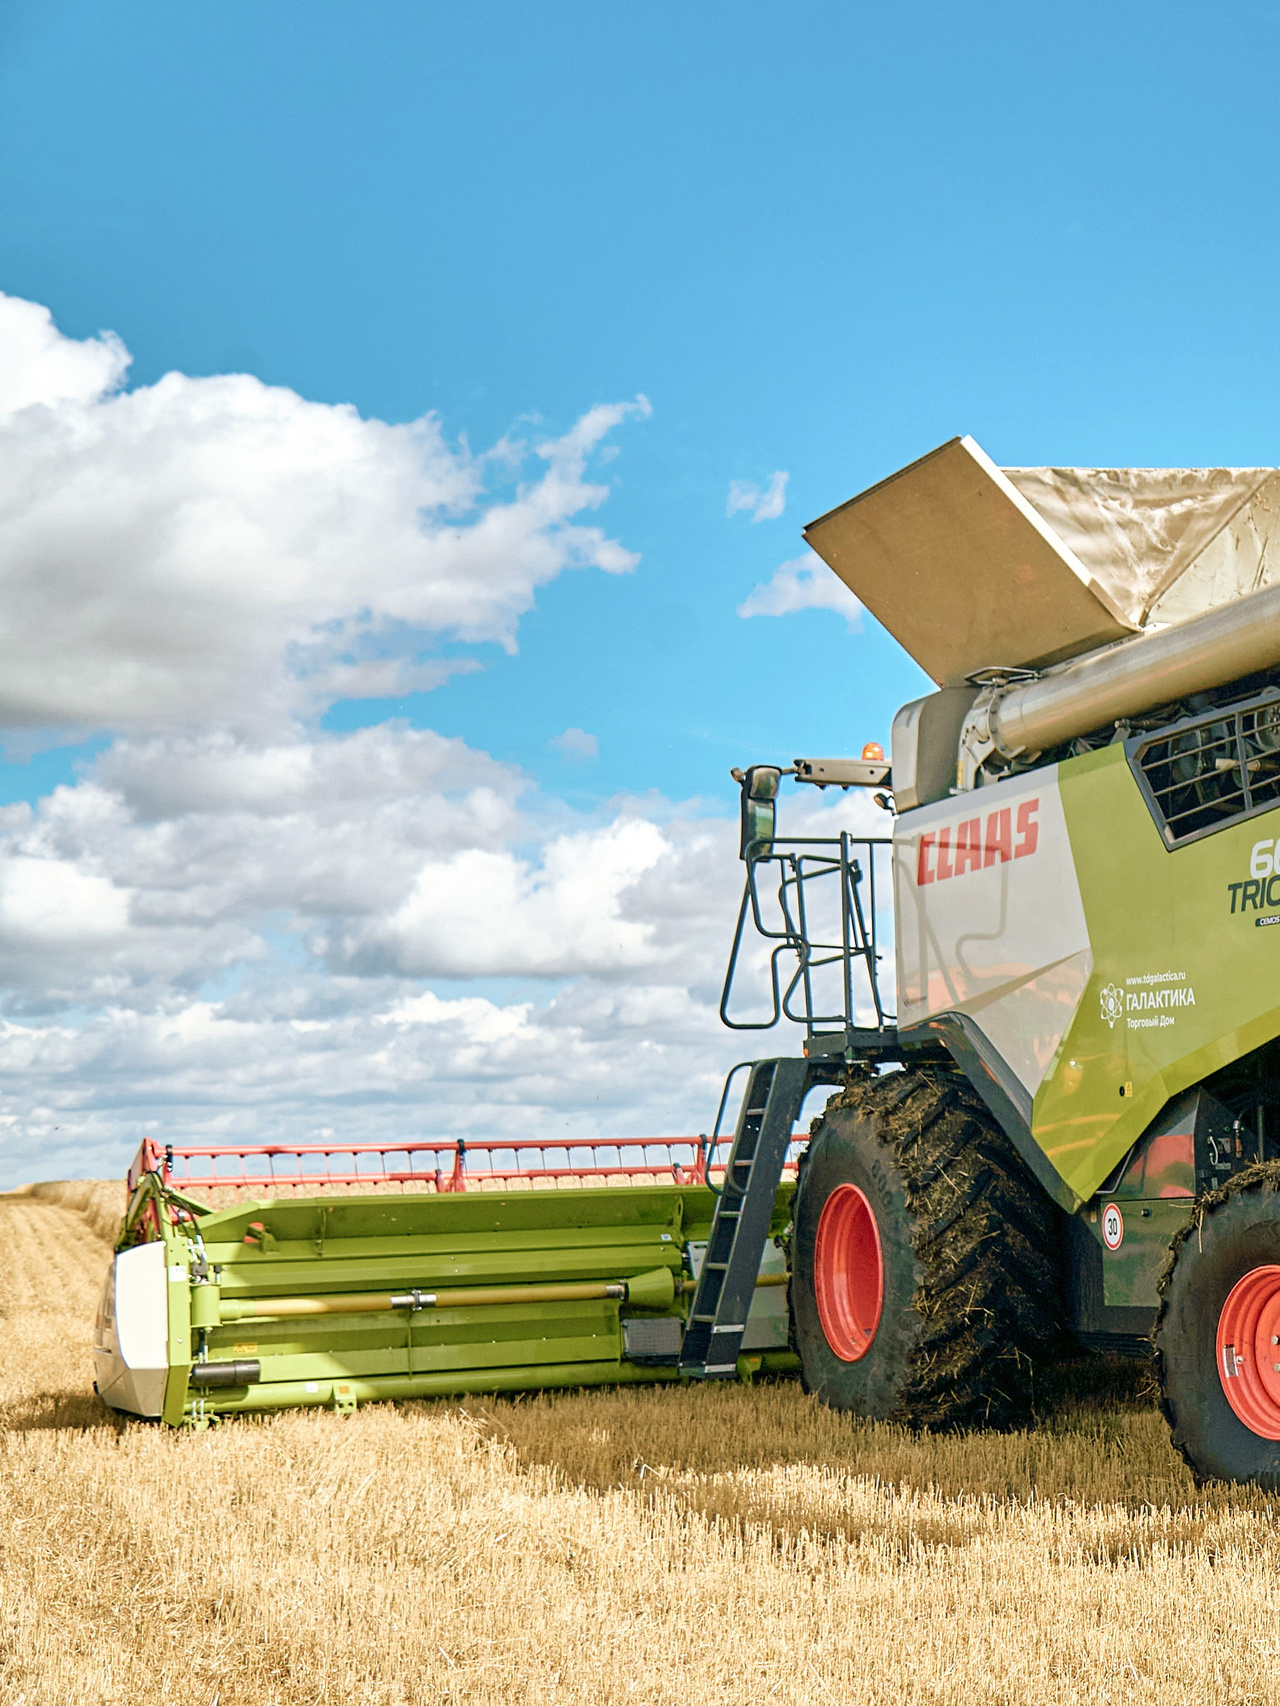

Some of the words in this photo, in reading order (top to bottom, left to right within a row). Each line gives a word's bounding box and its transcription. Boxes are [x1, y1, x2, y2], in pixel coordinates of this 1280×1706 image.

[917, 798, 1039, 886] CLAAS
[1260, 916, 1280, 925] CEMOS
[1126, 970, 1186, 985] www.tdgalactica.ru
[1126, 987, 1196, 1011] ГАЛАКТИКА
[1127, 1016, 1158, 1030] Торговый
[1159, 1015, 1175, 1027] Дом
[1108, 1218, 1118, 1235] 30
